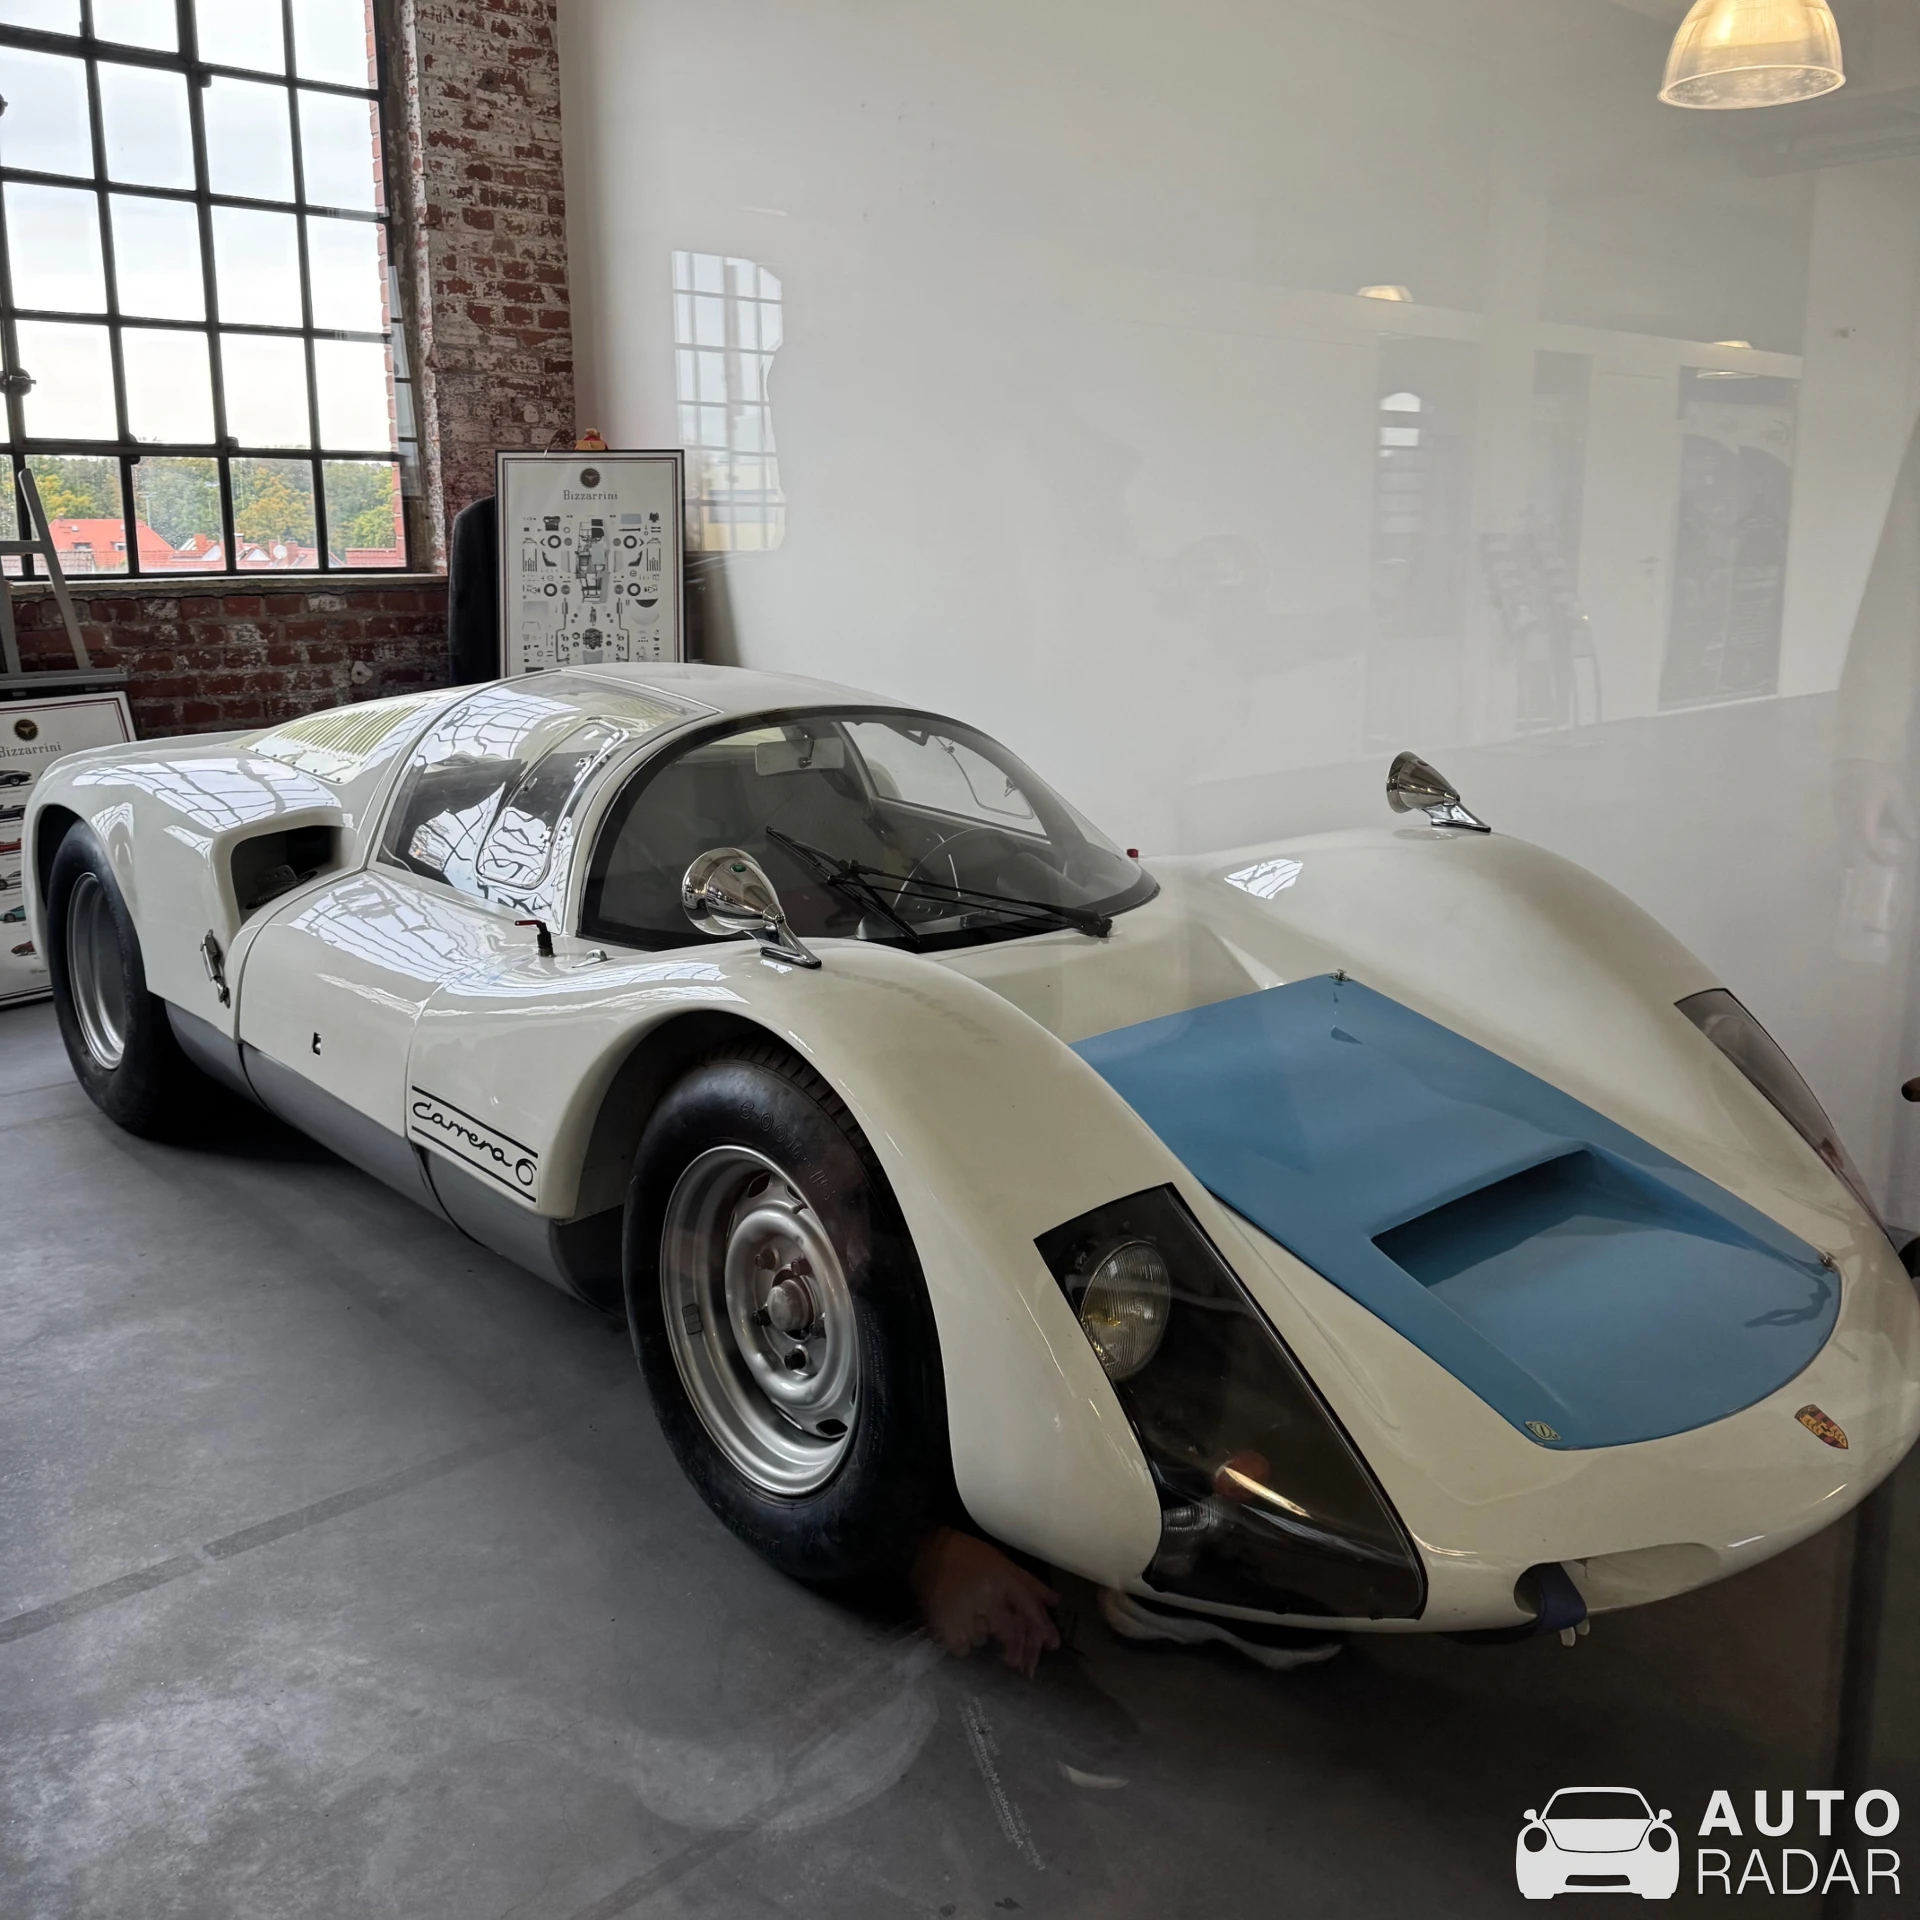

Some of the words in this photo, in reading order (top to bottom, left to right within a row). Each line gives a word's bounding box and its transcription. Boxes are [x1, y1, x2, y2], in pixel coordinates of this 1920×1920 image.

[563, 489, 618, 501] Bizzarrini
[412, 1101, 513, 1168] Carrera
[515, 1158, 538, 1186] 6
